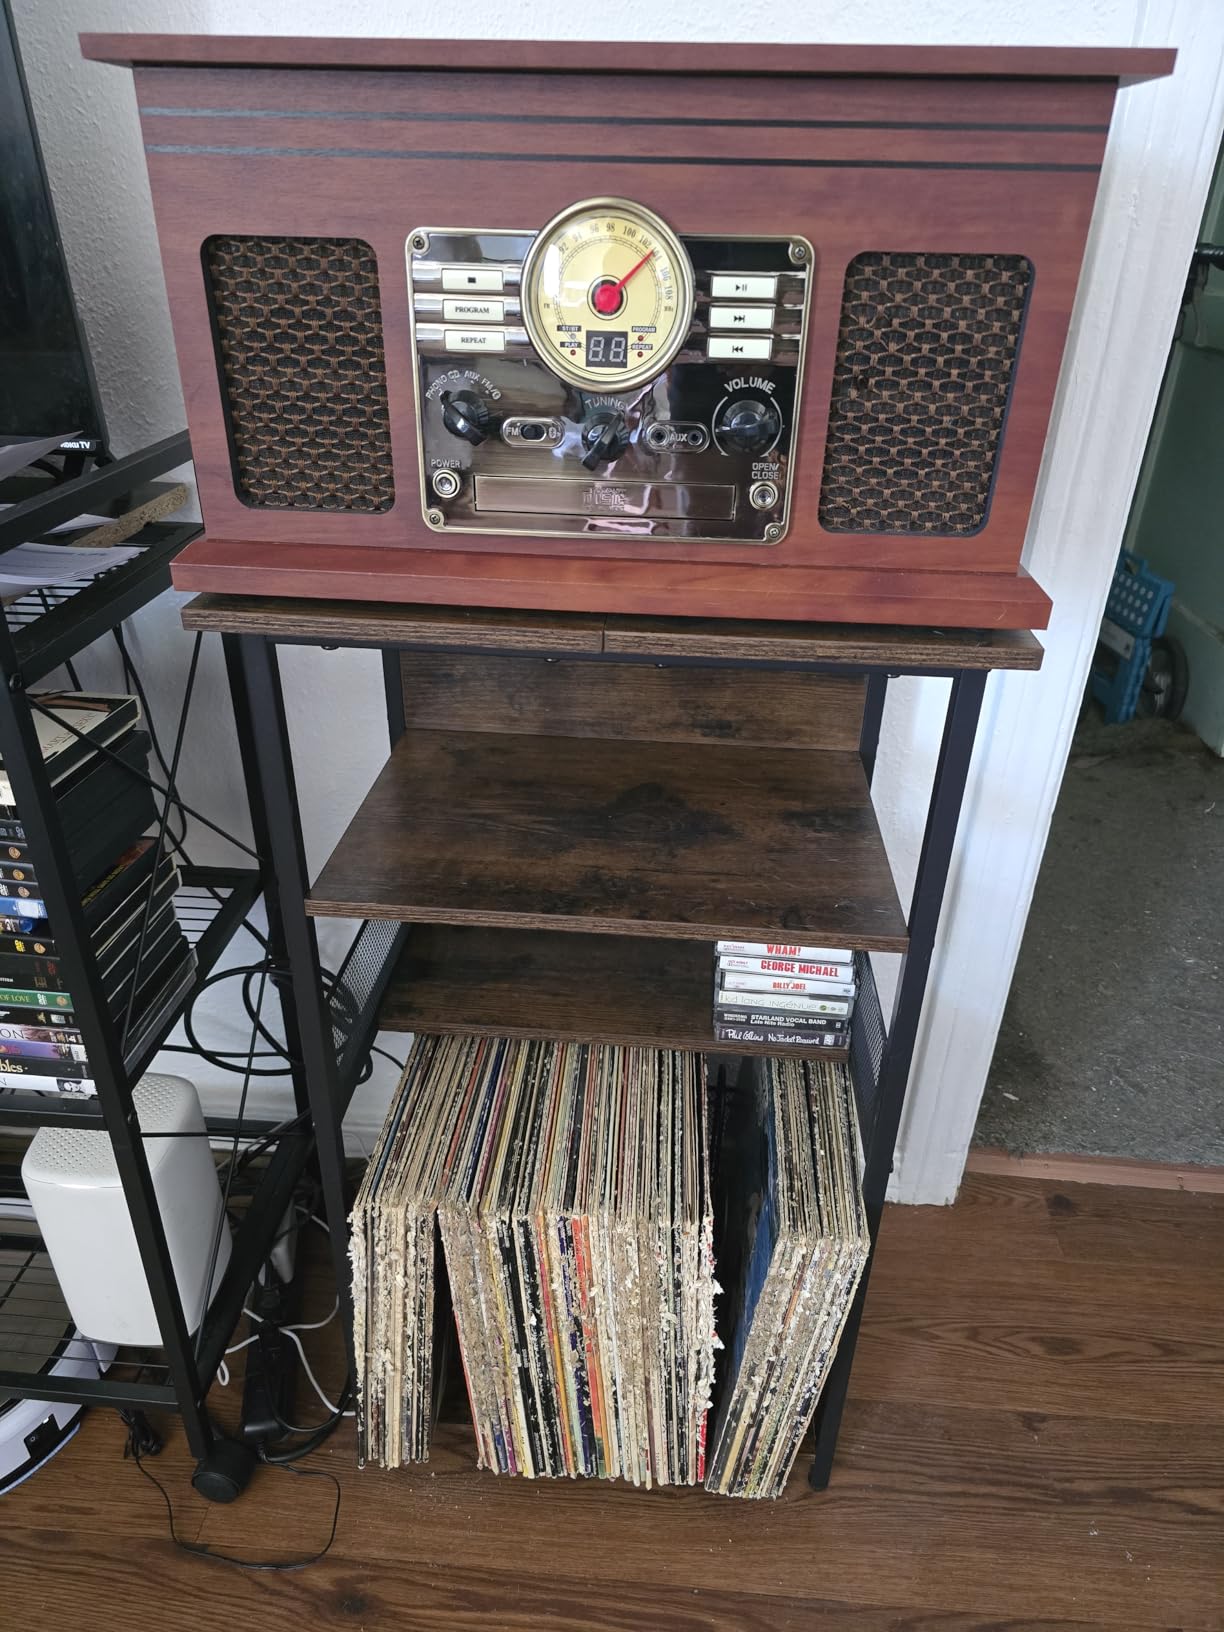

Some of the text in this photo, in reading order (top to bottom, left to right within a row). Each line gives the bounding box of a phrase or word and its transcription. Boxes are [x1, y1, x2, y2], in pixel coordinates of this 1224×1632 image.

[606, 222, 616, 232] 98
[622, 226, 637, 238] 100
[455, 306, 490, 314] PROGRAM
[460, 336, 487, 344] REPEAT
[425, 374, 448, 401] PHONO
[447, 369, 460, 380] CD
[464, 370, 481, 382] AUX
[723, 376, 776, 394] VOLUME
[584, 396, 625, 410] TUNING
[505, 426, 520, 437] FM
[670, 432, 688, 442] AUX
[79, 441, 90, 449] TV
[430, 458, 461, 469] POWER
[751, 471, 780, 480] CLOSE
[766, 944, 802, 956] WHAM!
[760, 960, 796, 973] GEORGE
[798, 963, 840, 978] MICHAEL
[772, 981, 790, 989] BILLY
[790, 982, 807, 990] JOEL
[750, 1014, 785, 1022] STARLAND
[726, 1029, 743, 1041] Phil
[742, 1030, 764, 1042] Collins
[767, 1033, 777, 1042] No
